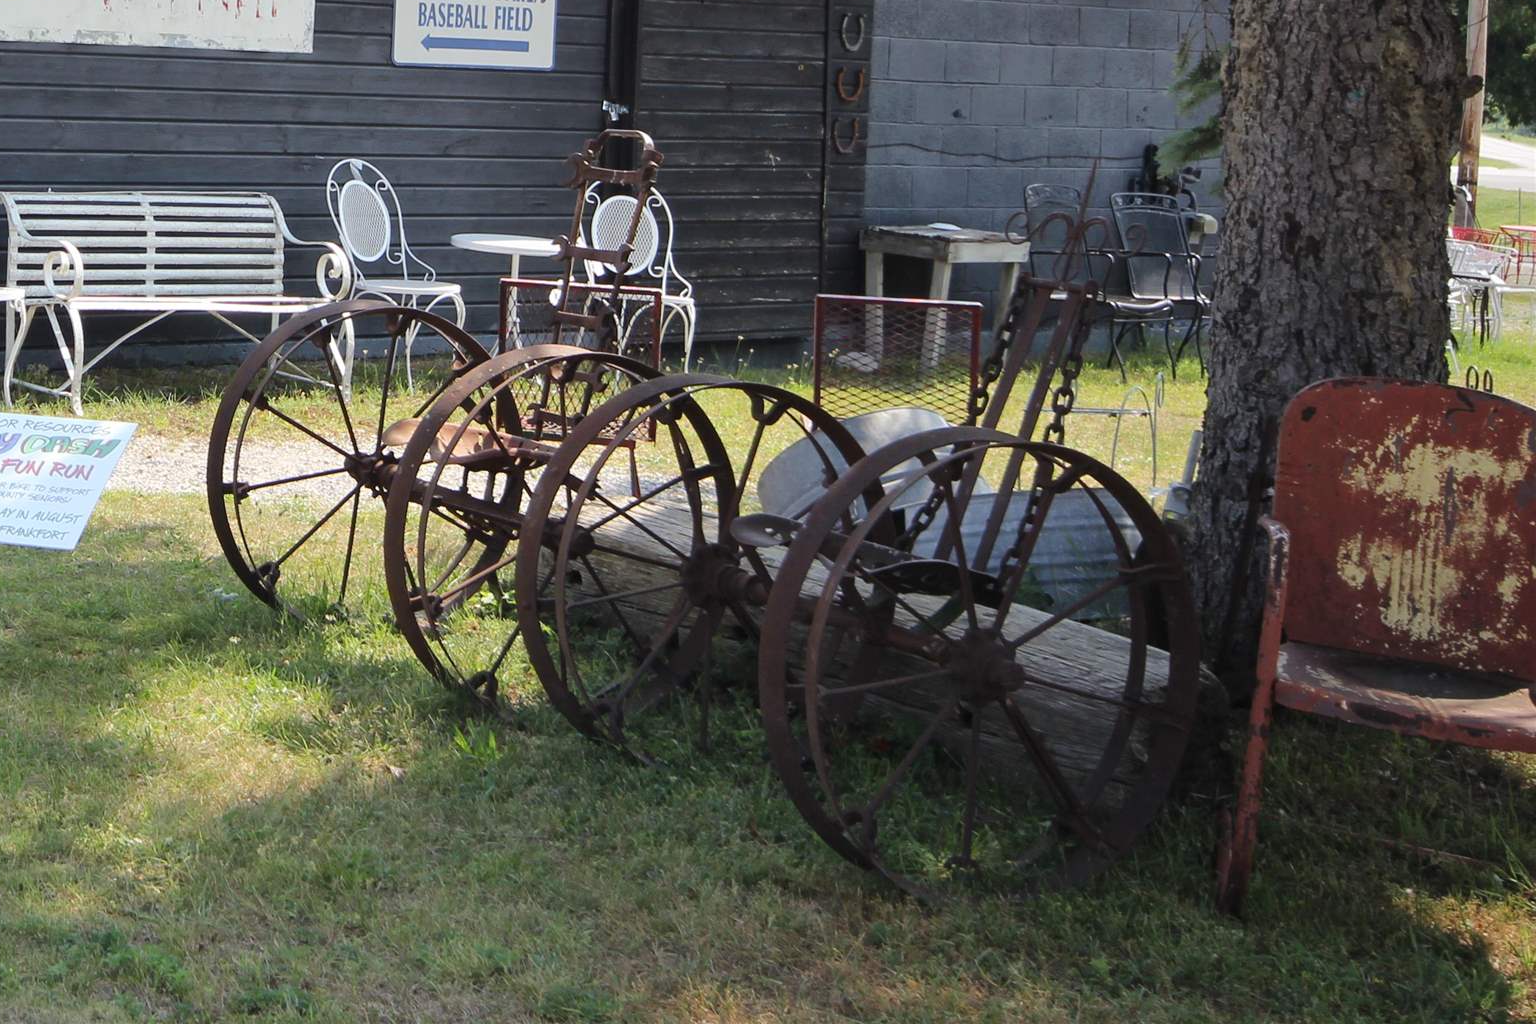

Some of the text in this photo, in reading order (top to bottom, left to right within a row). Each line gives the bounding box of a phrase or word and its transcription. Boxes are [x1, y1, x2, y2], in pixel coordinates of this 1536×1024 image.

[418, 2, 533, 32] BASEBALL FIELD
[23, 419, 112, 436] RESOURCES
[20, 434, 122, 459] DASH
[0, 457, 45, 477] FUN
[49, 461, 95, 481] RUN
[34, 484, 46, 493] TO
[48, 487, 96, 496] SUPPORT
[16, 509, 30, 520] IN
[32, 511, 83, 524] AUGUST
